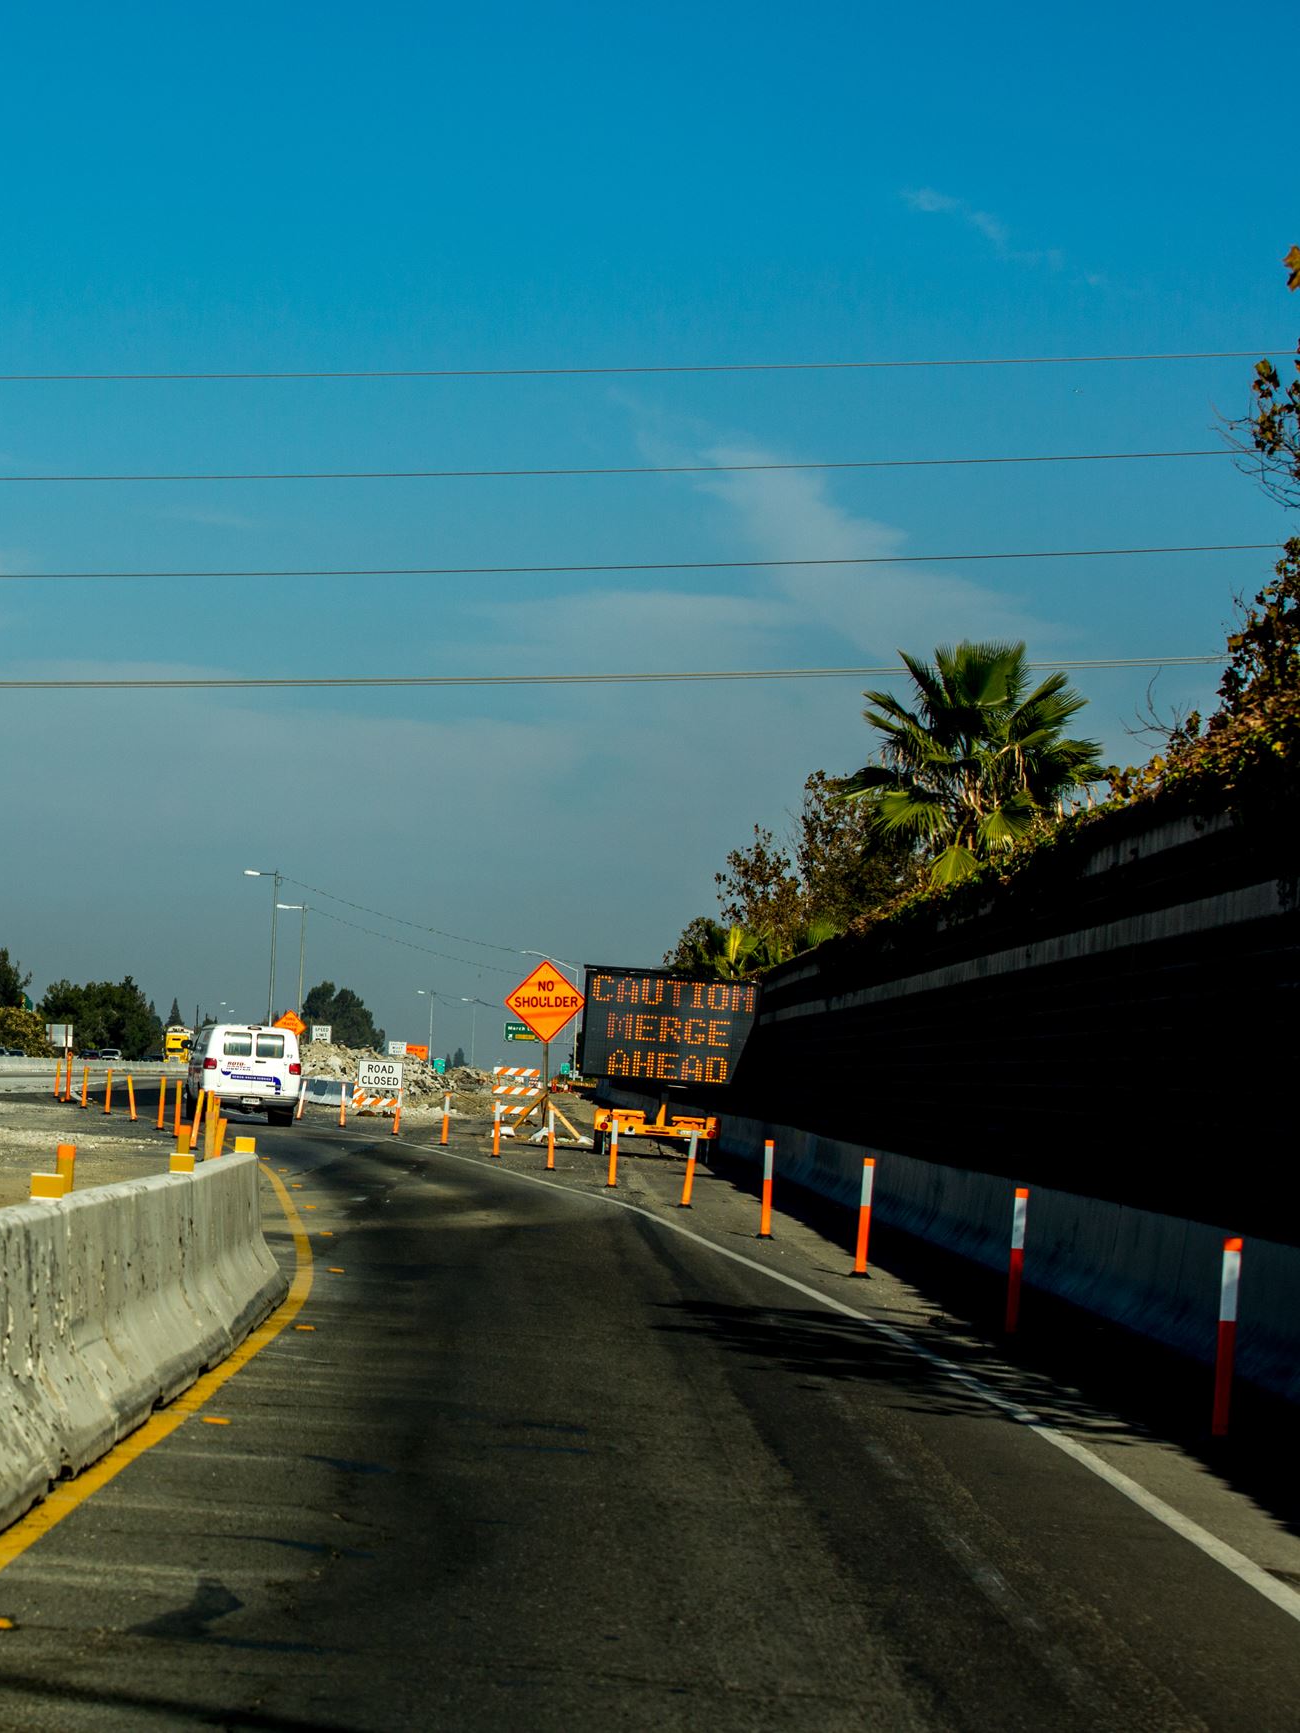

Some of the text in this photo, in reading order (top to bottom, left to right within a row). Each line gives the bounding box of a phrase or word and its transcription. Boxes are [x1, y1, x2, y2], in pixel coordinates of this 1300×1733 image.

[537, 980, 555, 992] NO
[592, 974, 755, 1013] CAUTION
[514, 996, 579, 1008] SHOULDER
[607, 1012, 731, 1047] MERGE
[367, 1064, 395, 1074] ROAD
[607, 1049, 728, 1083] AHEAD
[361, 1075, 399, 1086] CLOSED
